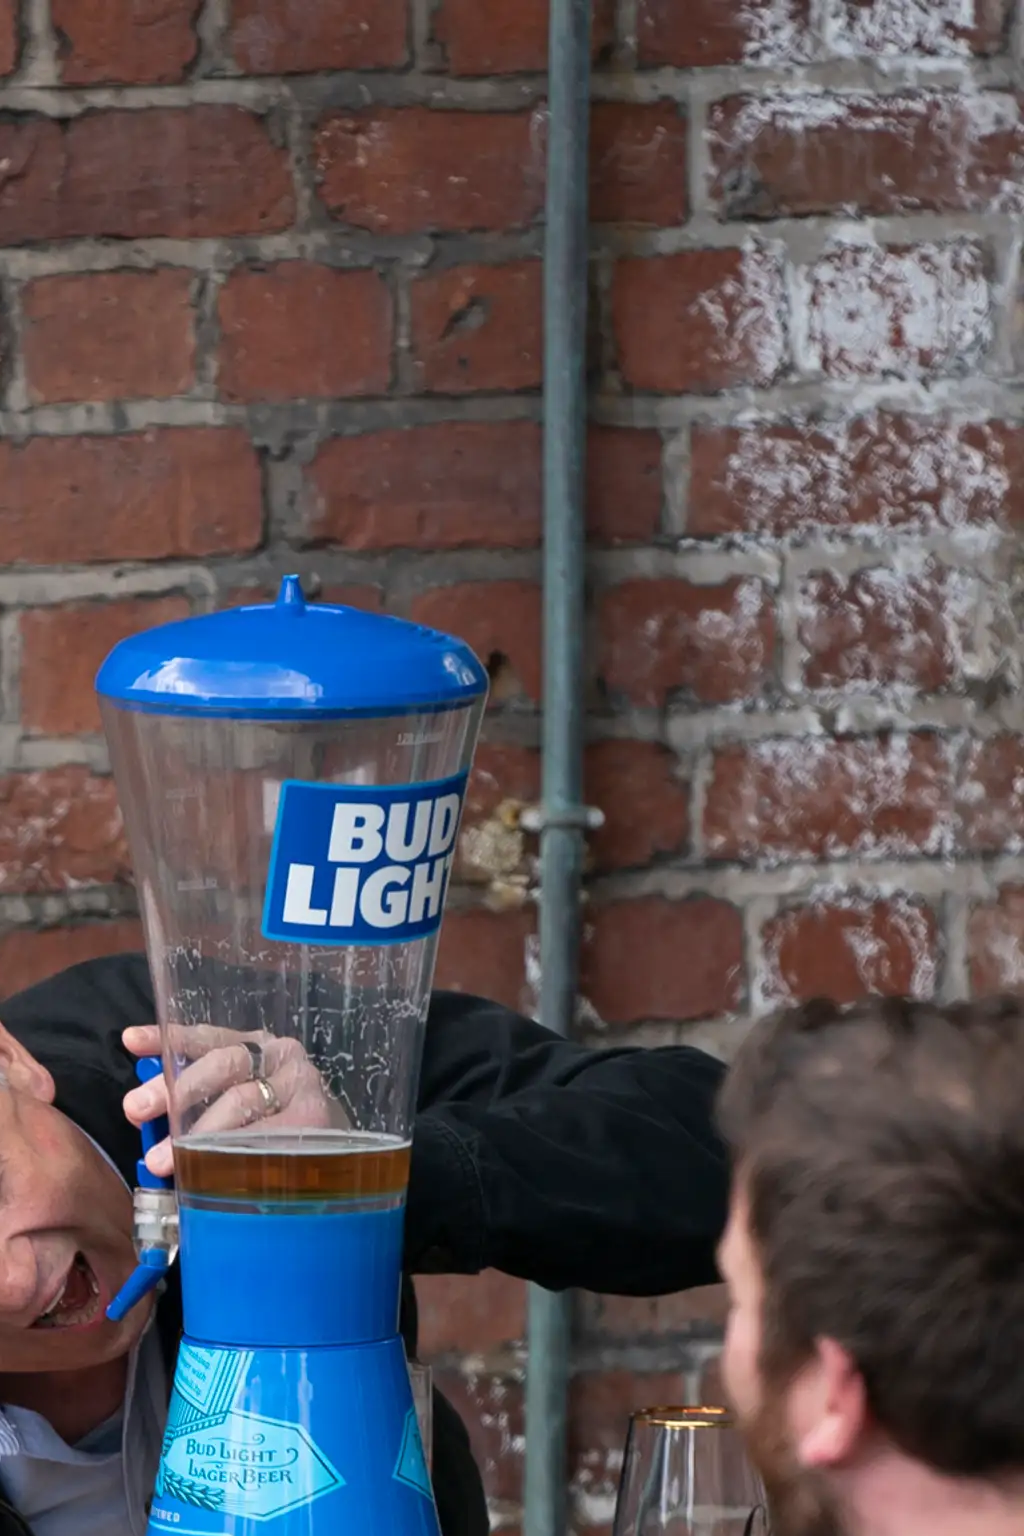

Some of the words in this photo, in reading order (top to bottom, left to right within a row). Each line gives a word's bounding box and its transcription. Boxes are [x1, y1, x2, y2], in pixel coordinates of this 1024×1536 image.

[328, 793, 460, 863] BUD
[282, 862, 451, 928] LIGH
[186, 1438, 216, 1456] BUD
[220, 1441, 277, 1463] LIGHT
[188, 1458, 244, 1487] LAGER
[243, 1468, 293, 1485] BEER
